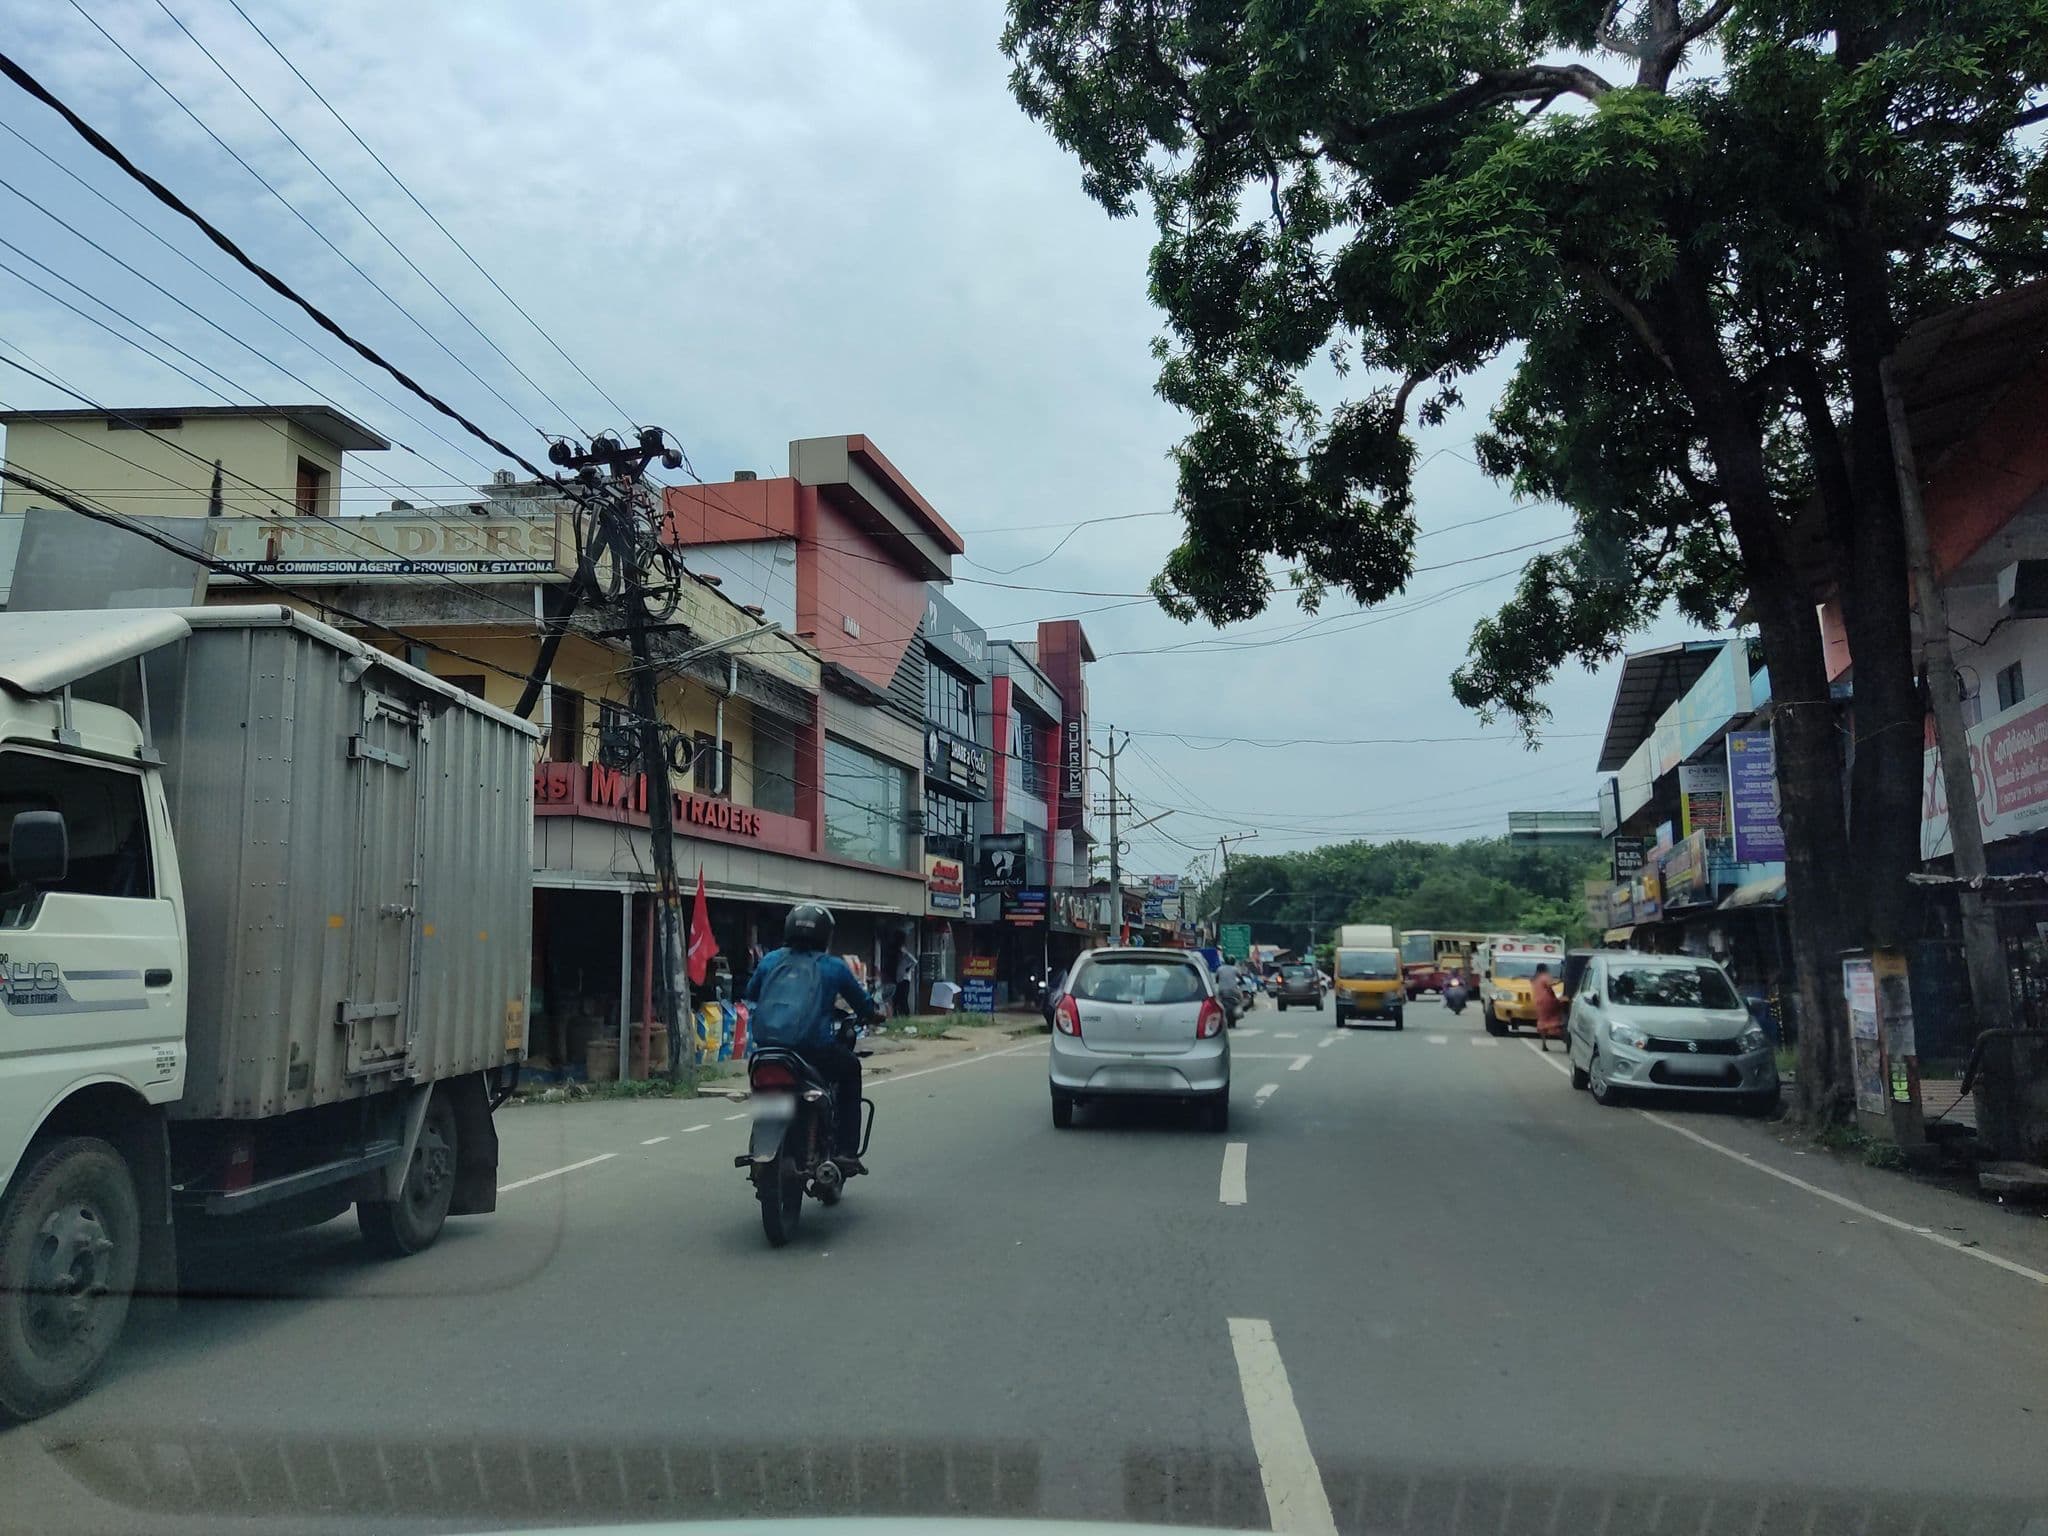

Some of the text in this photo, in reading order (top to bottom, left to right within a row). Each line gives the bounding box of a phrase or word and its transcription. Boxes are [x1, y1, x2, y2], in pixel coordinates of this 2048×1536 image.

[258, 526, 556, 556] TRADERS
[258, 564, 275, 572] AND
[276, 562, 357, 572] COMMISSION
[359, 562, 401, 572] AGENT
[413, 562, 478, 572] PROVISION
[1068, 722, 1081, 792] SUPREME
[678, 795, 762, 835] TRADERS
